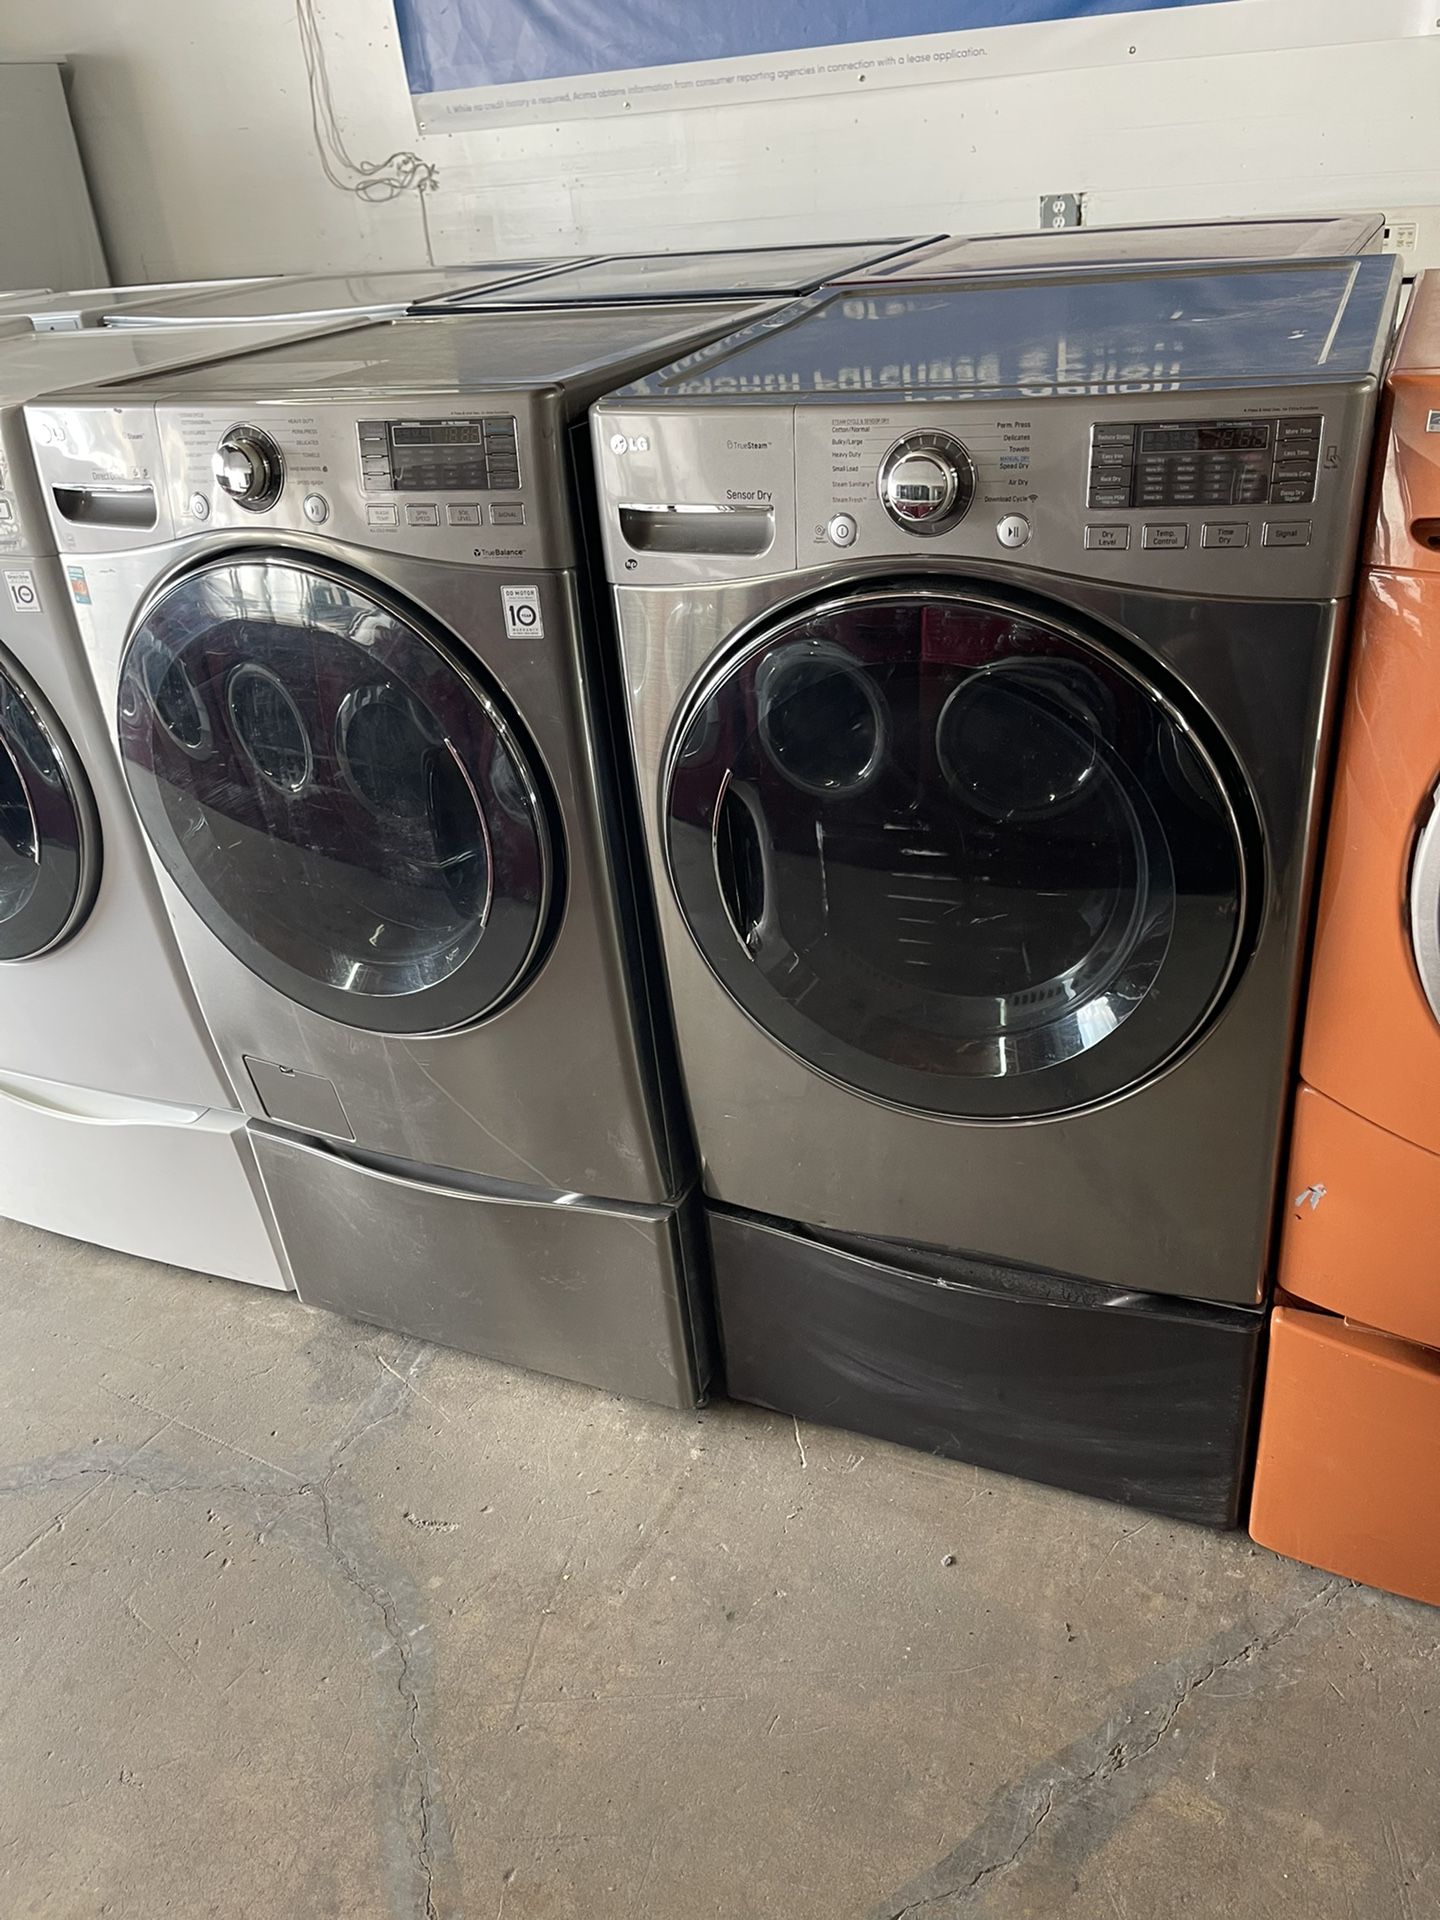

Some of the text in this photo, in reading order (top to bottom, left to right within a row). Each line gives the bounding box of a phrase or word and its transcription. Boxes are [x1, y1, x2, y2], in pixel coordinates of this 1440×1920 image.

[627, 83, 673, 95] information
[674, 79, 693, 89] from
[695, 75, 735, 88] consumer
[737, 71, 776, 84] reporting
[777, 65, 815, 80] agencies
[817, 64, 826, 74] in
[827, 58, 875, 73] connection
[877, 56, 896, 67] with
[898, 56, 905, 65] a
[907, 53, 931, 64] lease
[933, 46, 988, 63] application.
[1003, 434, 1031, 442] Delicates
[628, 436, 651, 451] LG
[1018, 462, 1029, 470] Dry
[1018, 479, 1029, 487] Dry
[726, 489, 773, 503] Sensor Dry
[1012, 495, 1028, 503] Cycle
[1102, 530, 1114, 540] Dry
[1218, 528, 1234, 537] Time
[1275, 529, 1298, 539] Signal
[1098, 537, 1117, 546] Level
[1153, 536, 1178, 545] Control
[1218, 535, 1231, 545] Dry
[11, 585, 34, 604] 10
[509, 604, 537, 627] 10
